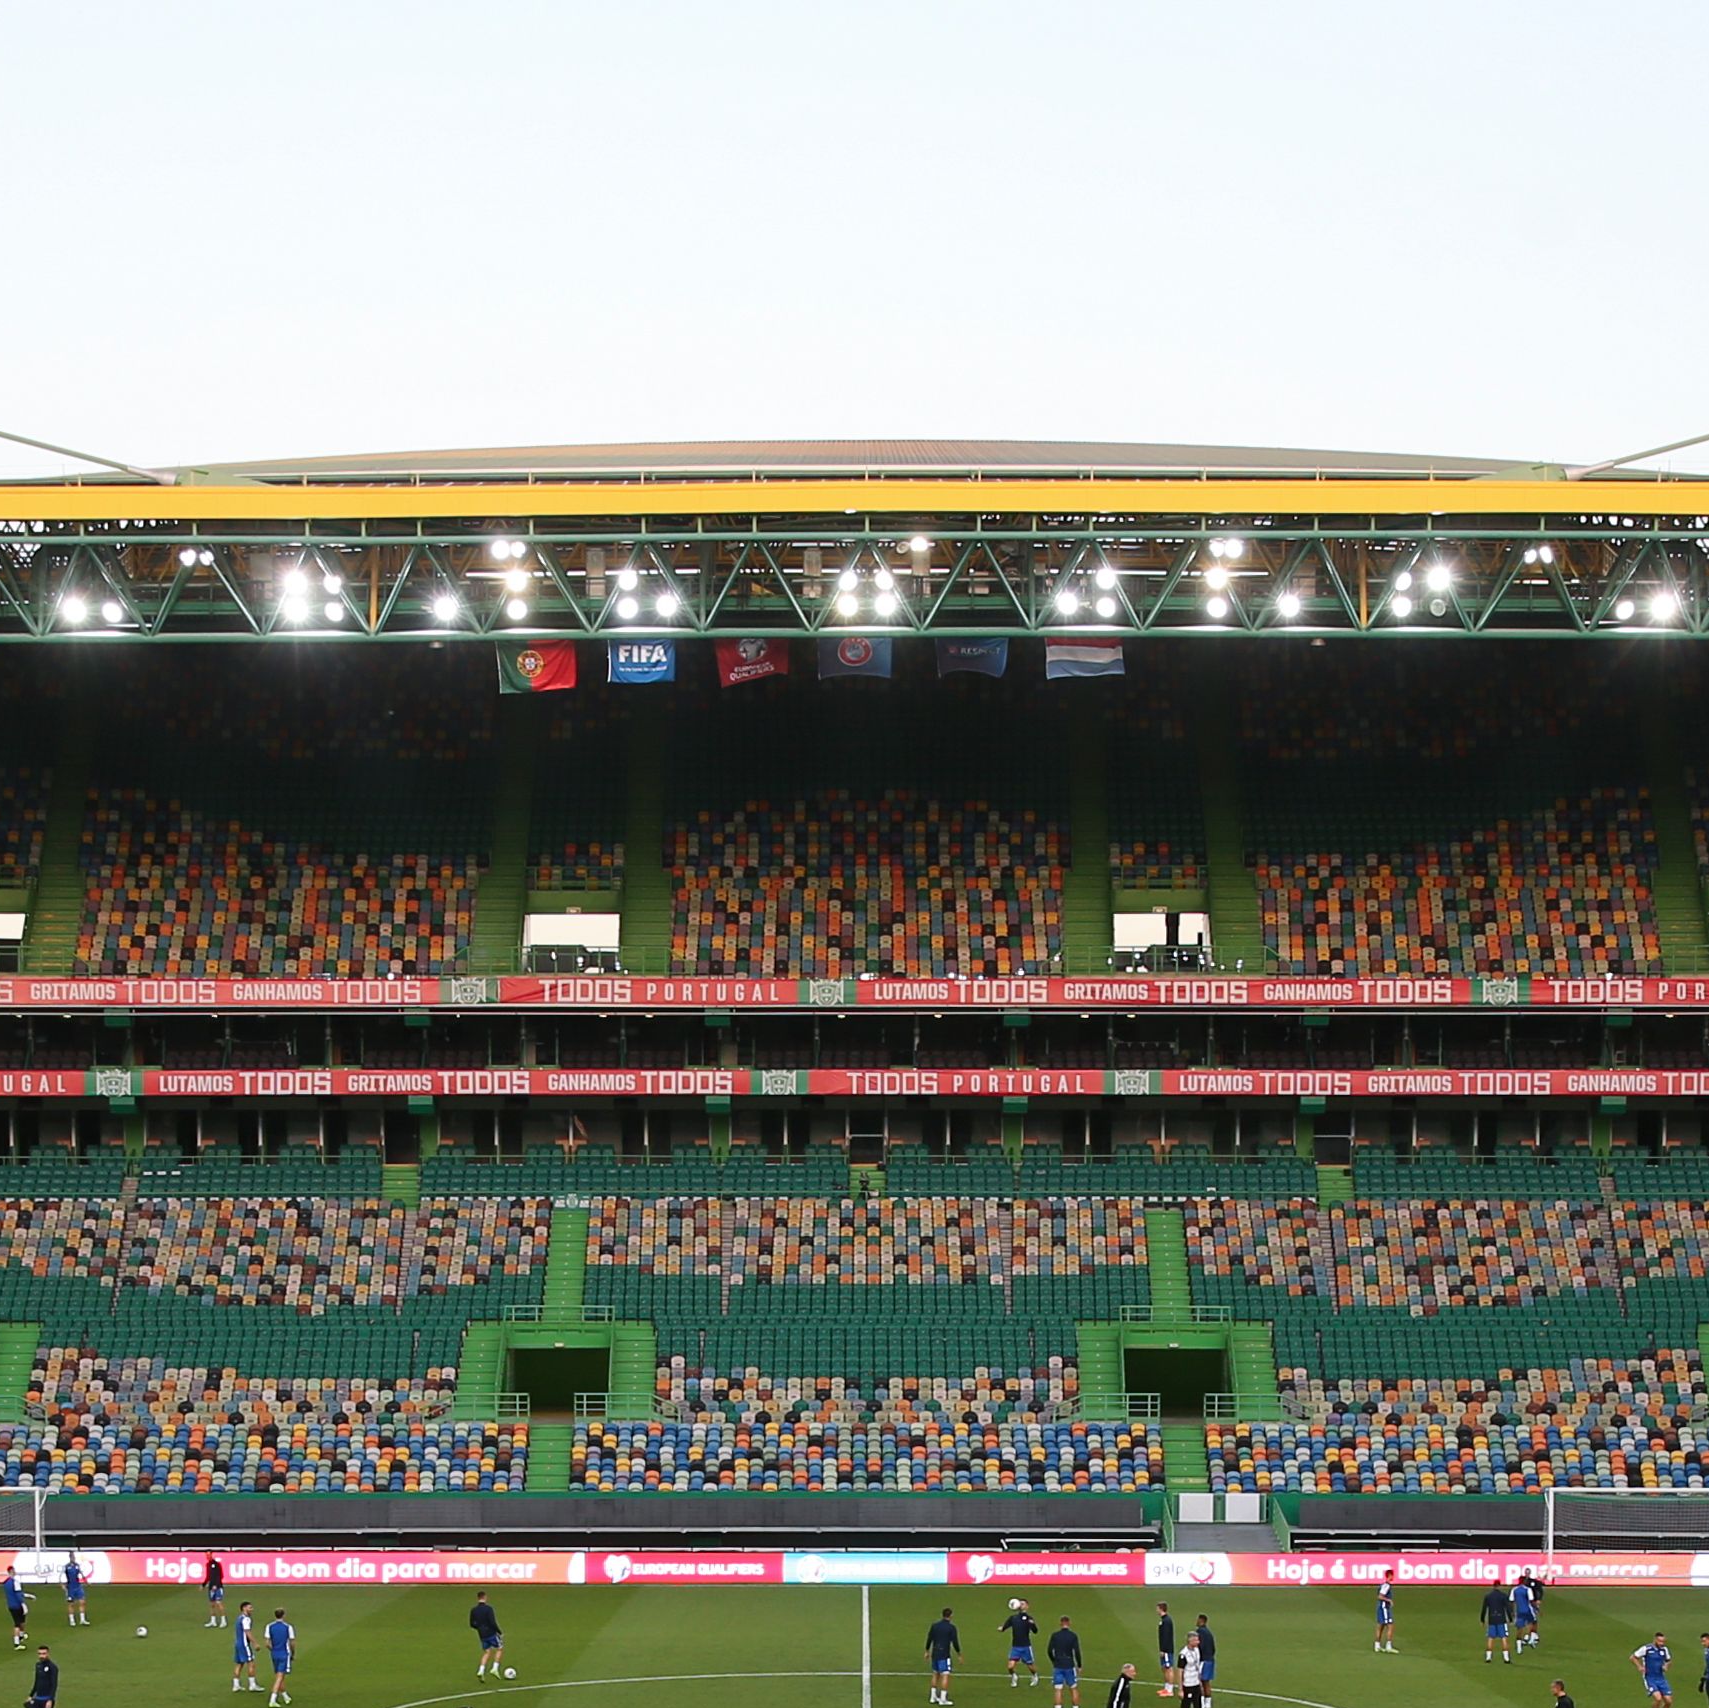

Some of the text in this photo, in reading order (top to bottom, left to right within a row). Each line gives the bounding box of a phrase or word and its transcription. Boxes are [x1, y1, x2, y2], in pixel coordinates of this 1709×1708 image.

[618, 645, 667, 663] FIFA
[29, 983, 118, 1002] GRITAMOS
[121, 980, 217, 1004] TODOS
[231, 983, 323, 1001] GANHAMOS
[327, 980, 421, 1004] TODOS
[539, 980, 780, 1004] TODOS PORTUGAL
[875, 980, 1451, 1004] LUTAMOS TODOS GRITAMOS TODOS GANHAMOS TODOS
[1549, 979, 1643, 1004] TODOS
[160, 1071, 733, 1095] LUTAMOS TODOS GRITAMOS TODOS GANHAMOS TODOS
[846, 1071, 1086, 1095] TODOS PORTUGAL
[1180, 1074, 1253, 1093] LUTAMOS
[1259, 1071, 1351, 1095] TODOS
[1368, 1074, 1452, 1093] GRITAMOS
[1458, 1071, 1551, 1095] TODOS
[1568, 1074, 1656, 1093] GANHAMOS
[146, 1557, 202, 1583] Hoje
[229, 1557, 539, 1583] um bom dia para marcar
[633, 1563, 765, 1576] EUROPEAN QUALIFIERS
[996, 1563, 1129, 1576] EUROPEAN QUALIFIERS
[1153, 1562, 1184, 1578] galp
[1267, 1558, 1324, 1584] Hoje
[1330, 1558, 1346, 1580] é
[1398, 1558, 1454, 1580] bom
[1460, 1558, 1499, 1580] dia
